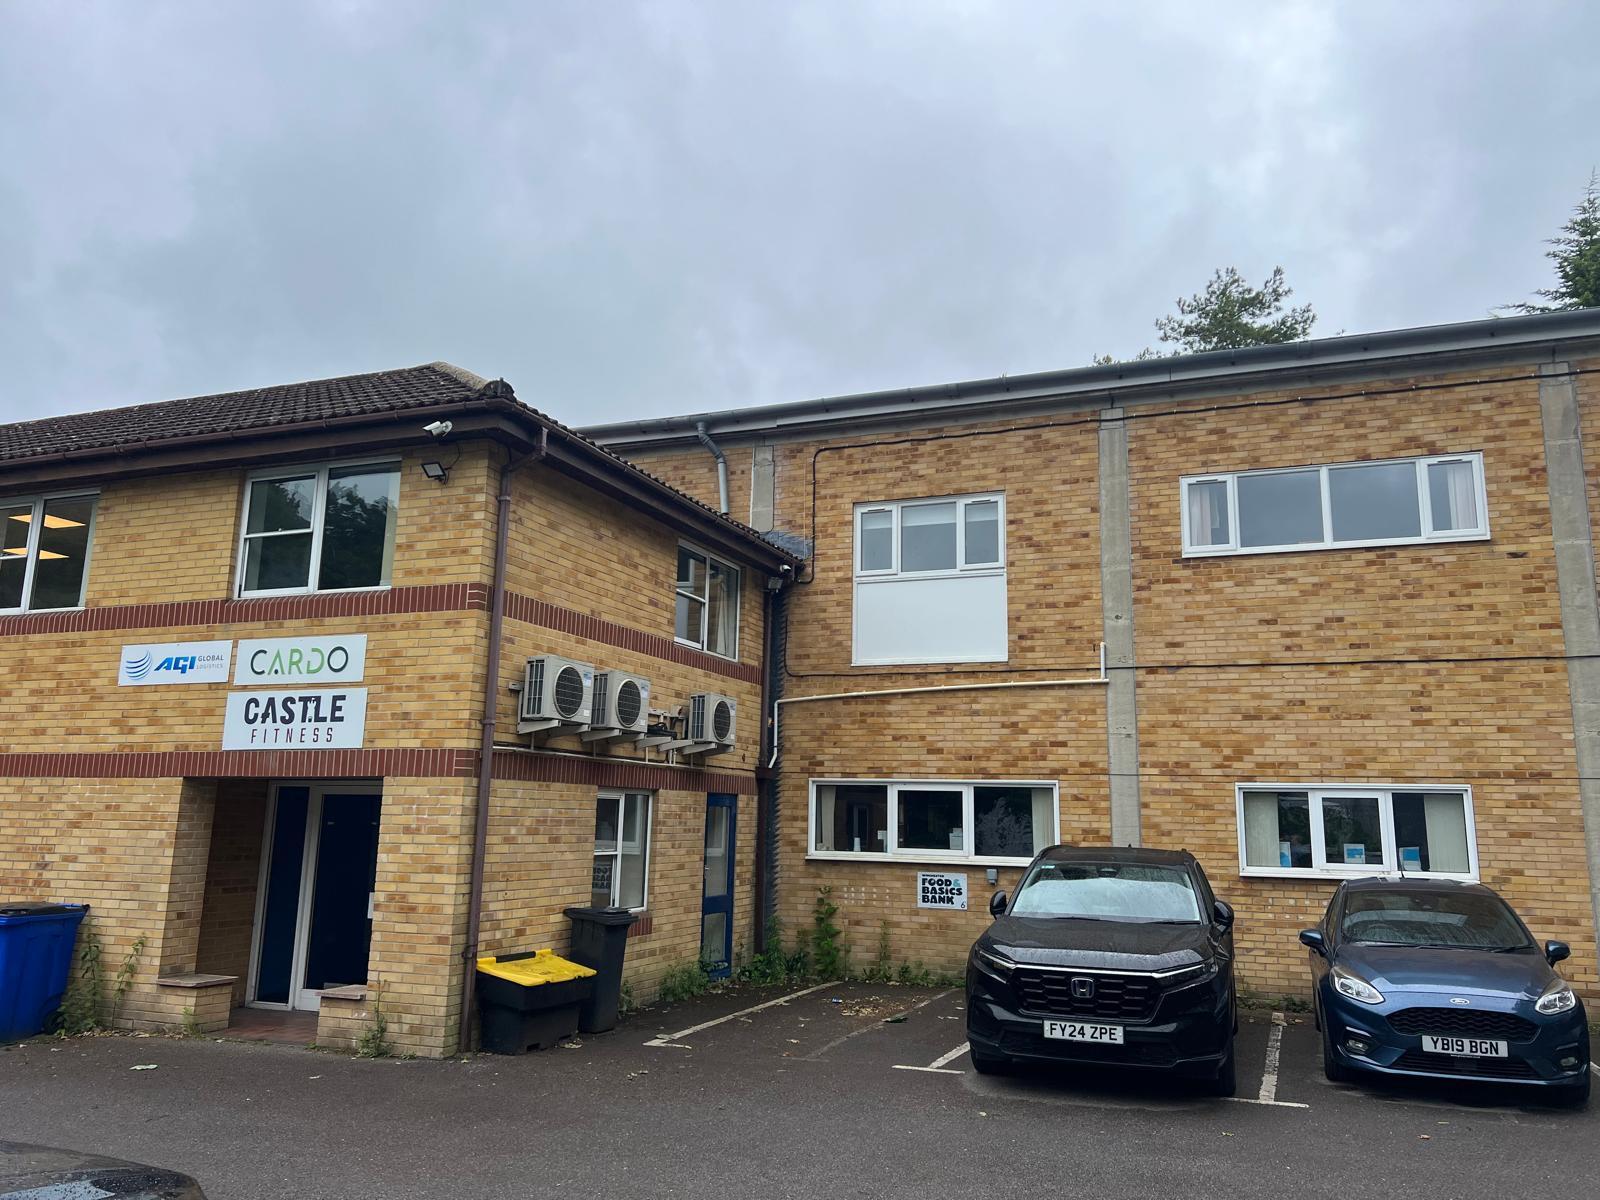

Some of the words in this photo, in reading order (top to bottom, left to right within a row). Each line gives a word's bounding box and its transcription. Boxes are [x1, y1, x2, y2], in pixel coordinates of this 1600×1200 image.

[154, 656, 196, 674] AGI
[250, 646, 349, 675] CARDO
[244, 695, 347, 724] CASTLE
[250, 727, 333, 744] FITNESS
[922, 878, 952, 886] FOOD
[953, 879, 961, 887] &
[922, 886, 963, 896] BASICS
[922, 895, 955, 905] BANK
[961, 901, 966, 909] 6
[1050, 1023, 1086, 1038] FY24
[1090, 1026, 1118, 1041] ZPE
[1431, 1037, 1465, 1052] YB19
[1469, 1040, 1499, 1055] BGN
